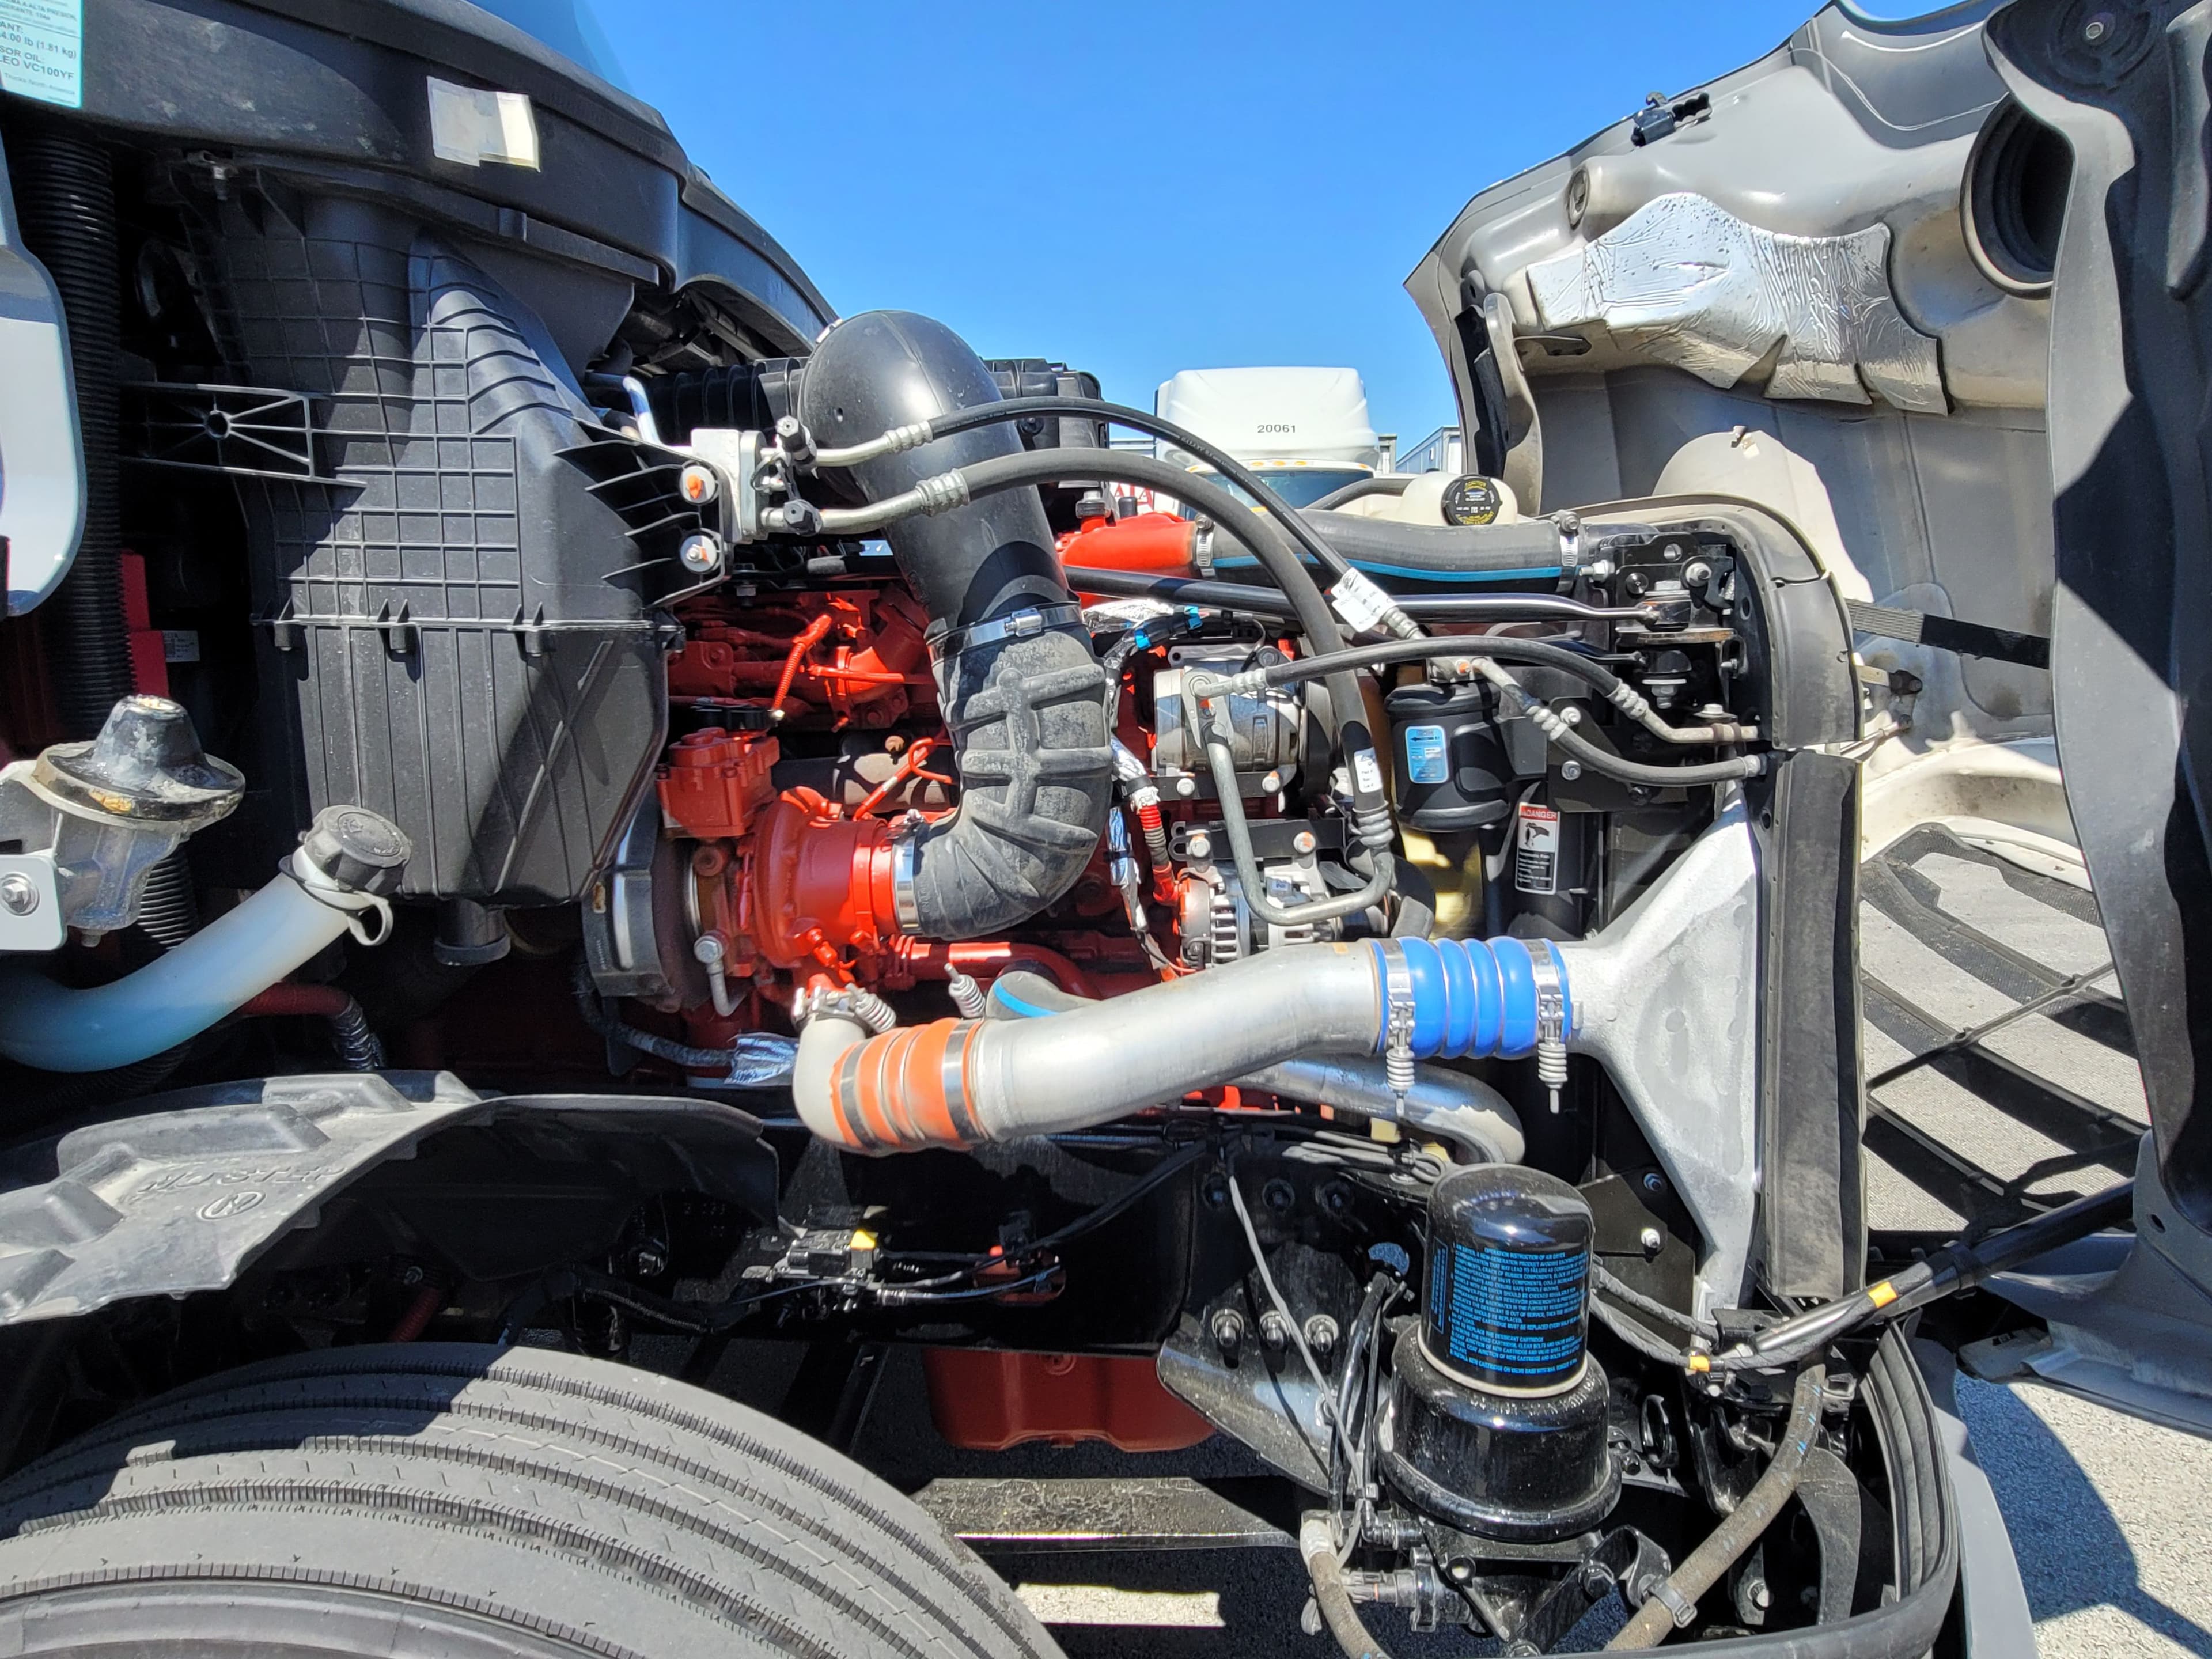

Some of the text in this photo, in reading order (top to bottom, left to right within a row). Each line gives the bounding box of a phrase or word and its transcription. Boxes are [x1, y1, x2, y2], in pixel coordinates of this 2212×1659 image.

[23, 60, 74, 81] VC100YF
[1257, 424, 1296, 434] 20061
[1527, 809, 1558, 819] DANGER
[215, 1166, 348, 1184] STEP
